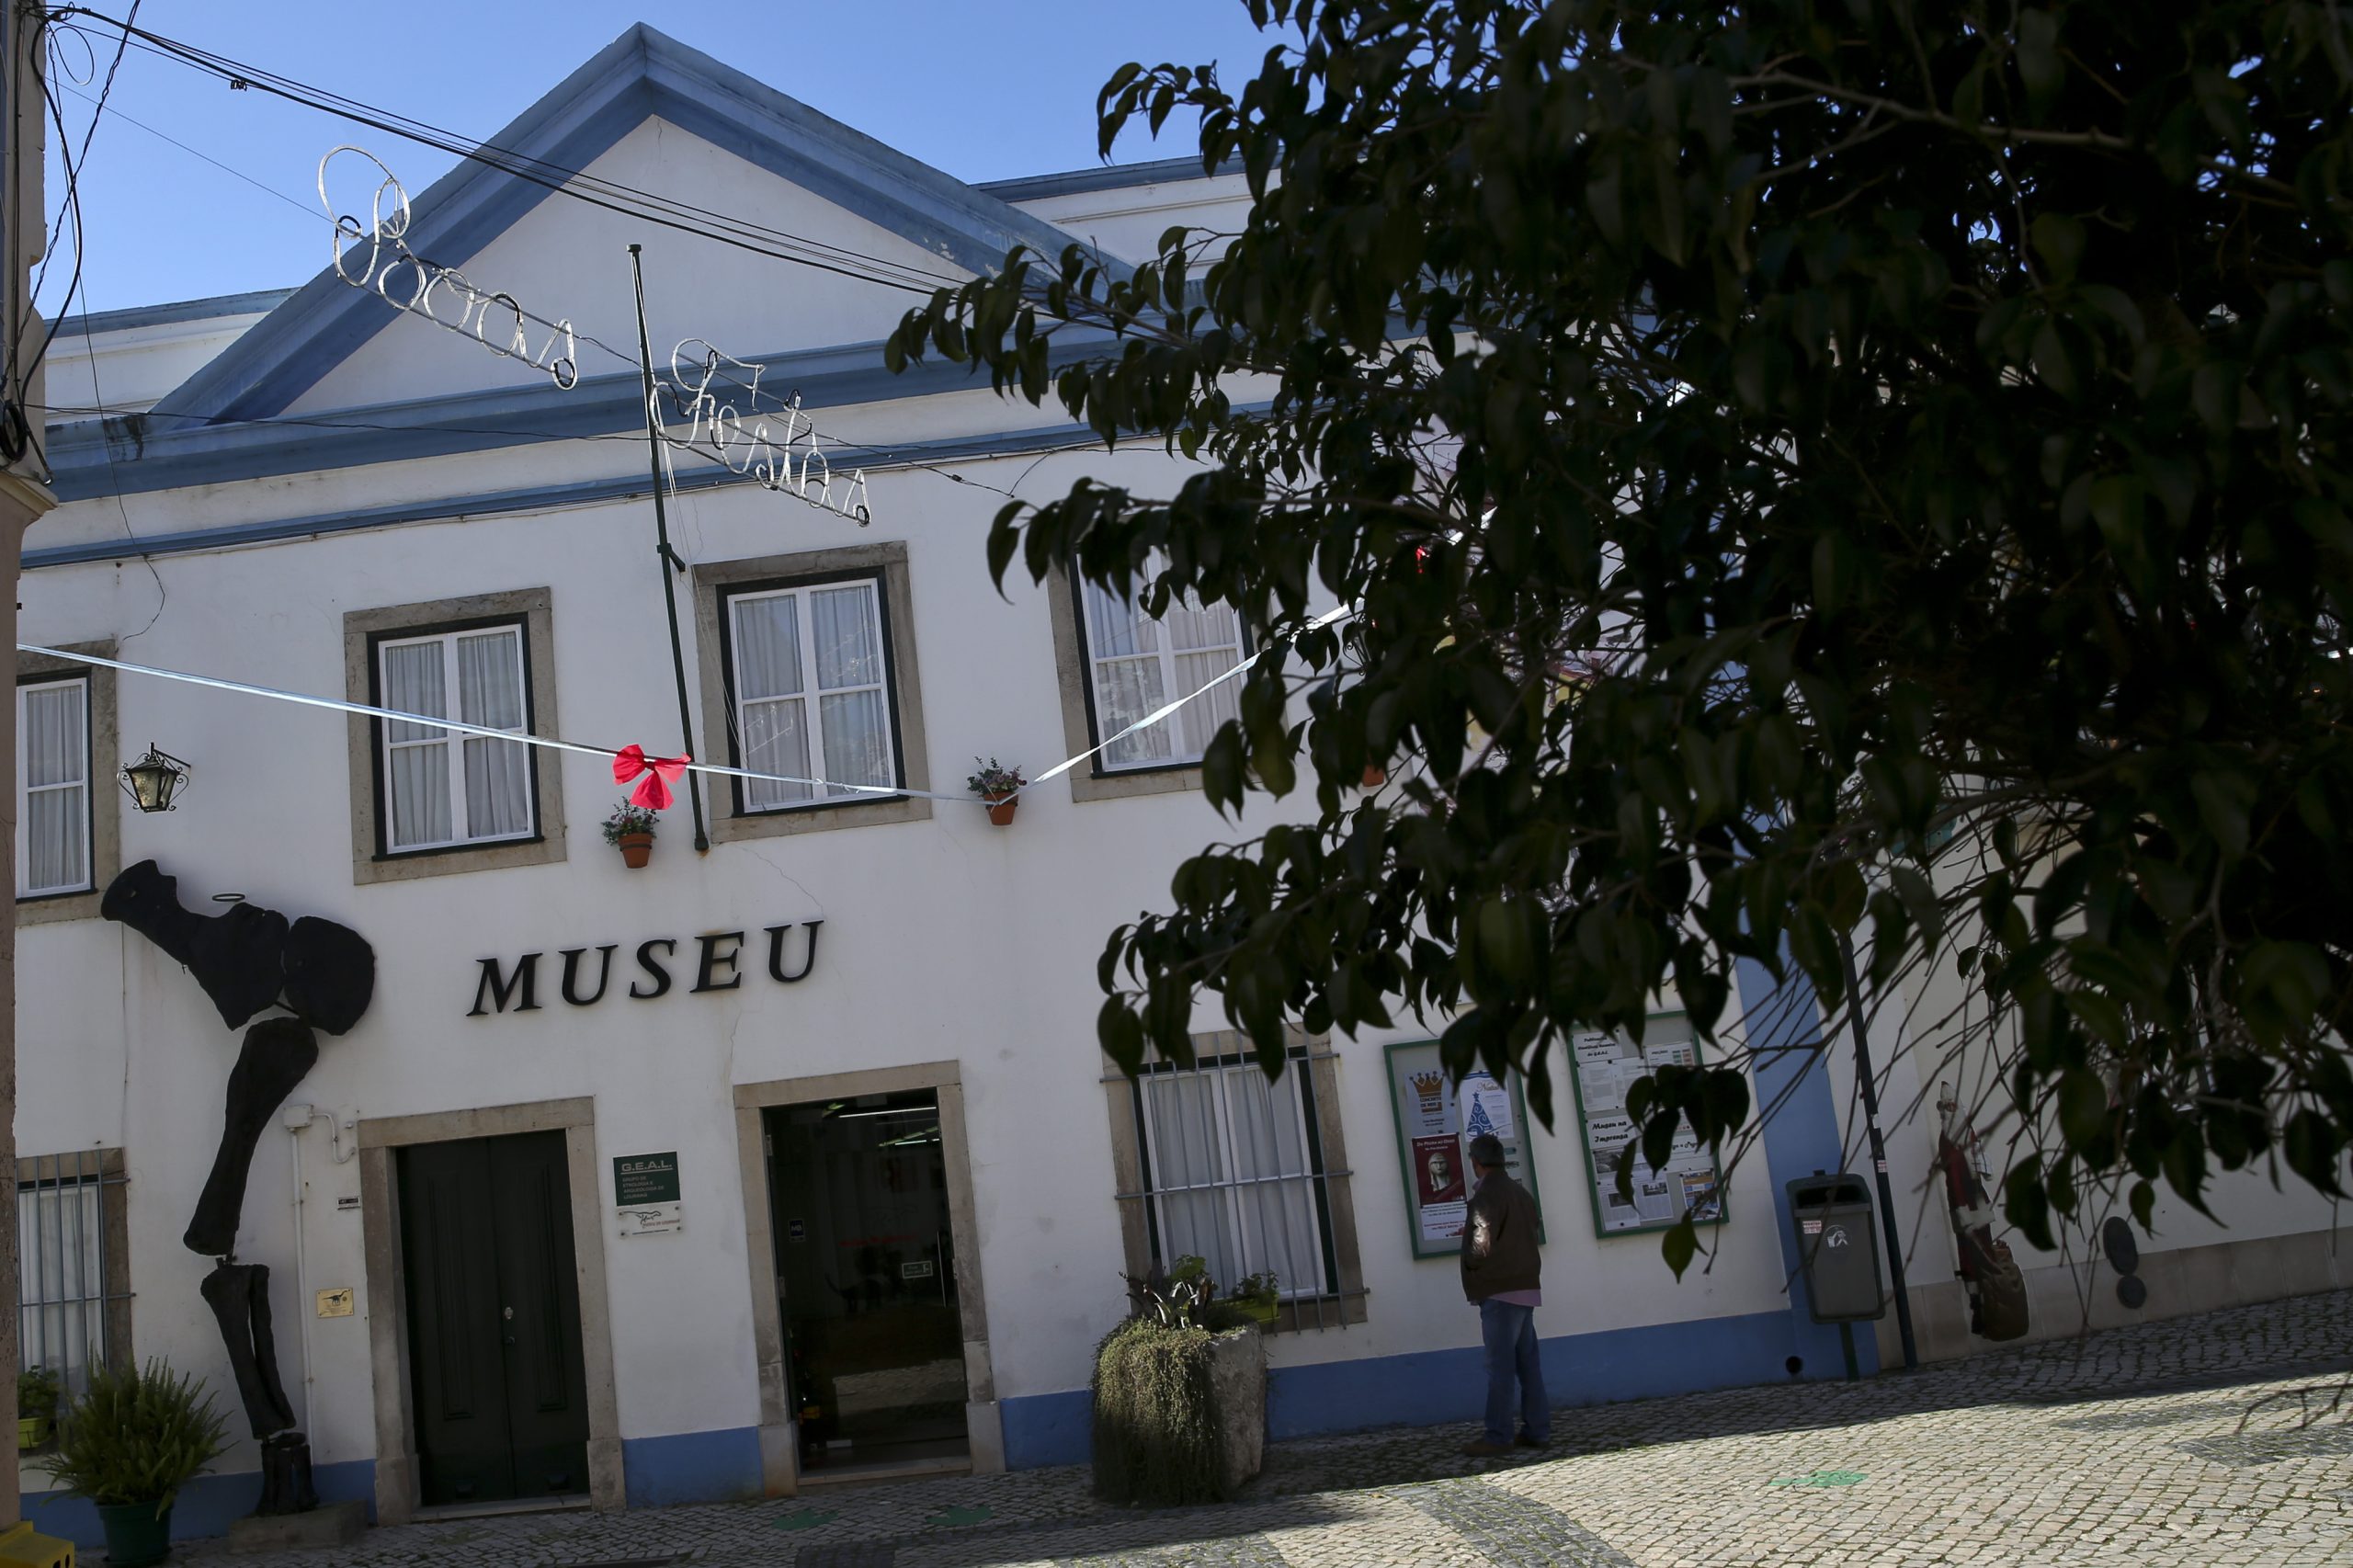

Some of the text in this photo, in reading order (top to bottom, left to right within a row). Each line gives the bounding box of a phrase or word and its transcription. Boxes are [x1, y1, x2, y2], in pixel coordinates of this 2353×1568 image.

[466, 920, 825, 1017] MUSEU
[1592, 1120, 1617, 1131] Museu
[1594, 1132, 1629, 1143] Imprensa
[621, 1160, 672, 1172] G.E.A.L.
